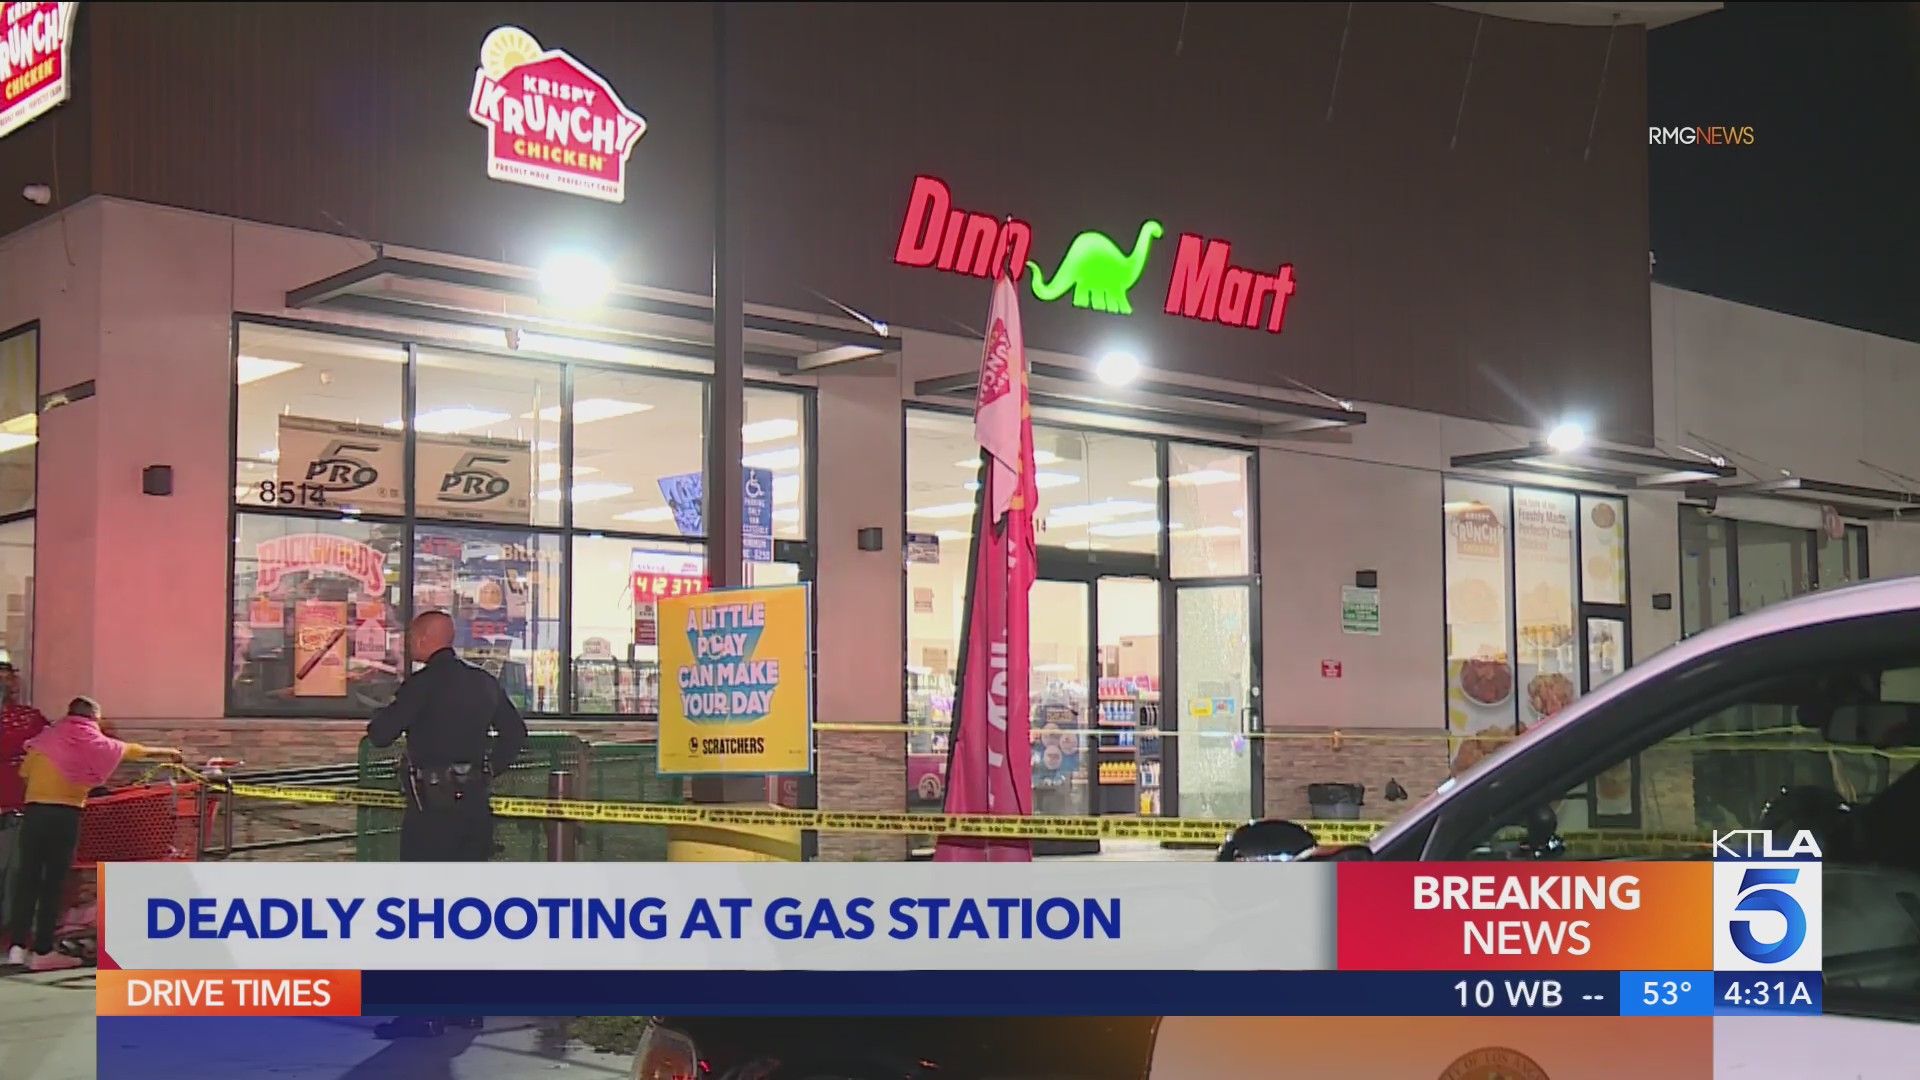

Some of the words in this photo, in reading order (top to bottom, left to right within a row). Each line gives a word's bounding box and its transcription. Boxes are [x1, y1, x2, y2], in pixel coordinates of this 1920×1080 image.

[523, 74, 595, 106] KRISPY
[478, 80, 638, 155] KRUNCHY
[513, 139, 604, 172] CHICKEN
[893, 174, 1032, 283] Dino
[1164, 232, 1296, 334] Mart
[305, 460, 378, 485] PRO
[440, 472, 510, 495] PRO
[259, 480, 327, 506] 8514
[686, 607, 698, 632] A
[701, 602, 765, 630] LITTLE
[678, 663, 713, 688] CAN
[718, 659, 780, 686] MAKE
[680, 692, 729, 717] YOUR
[731, 688, 775, 715] DAY
[702, 736, 765, 755] SCRATCHERS
